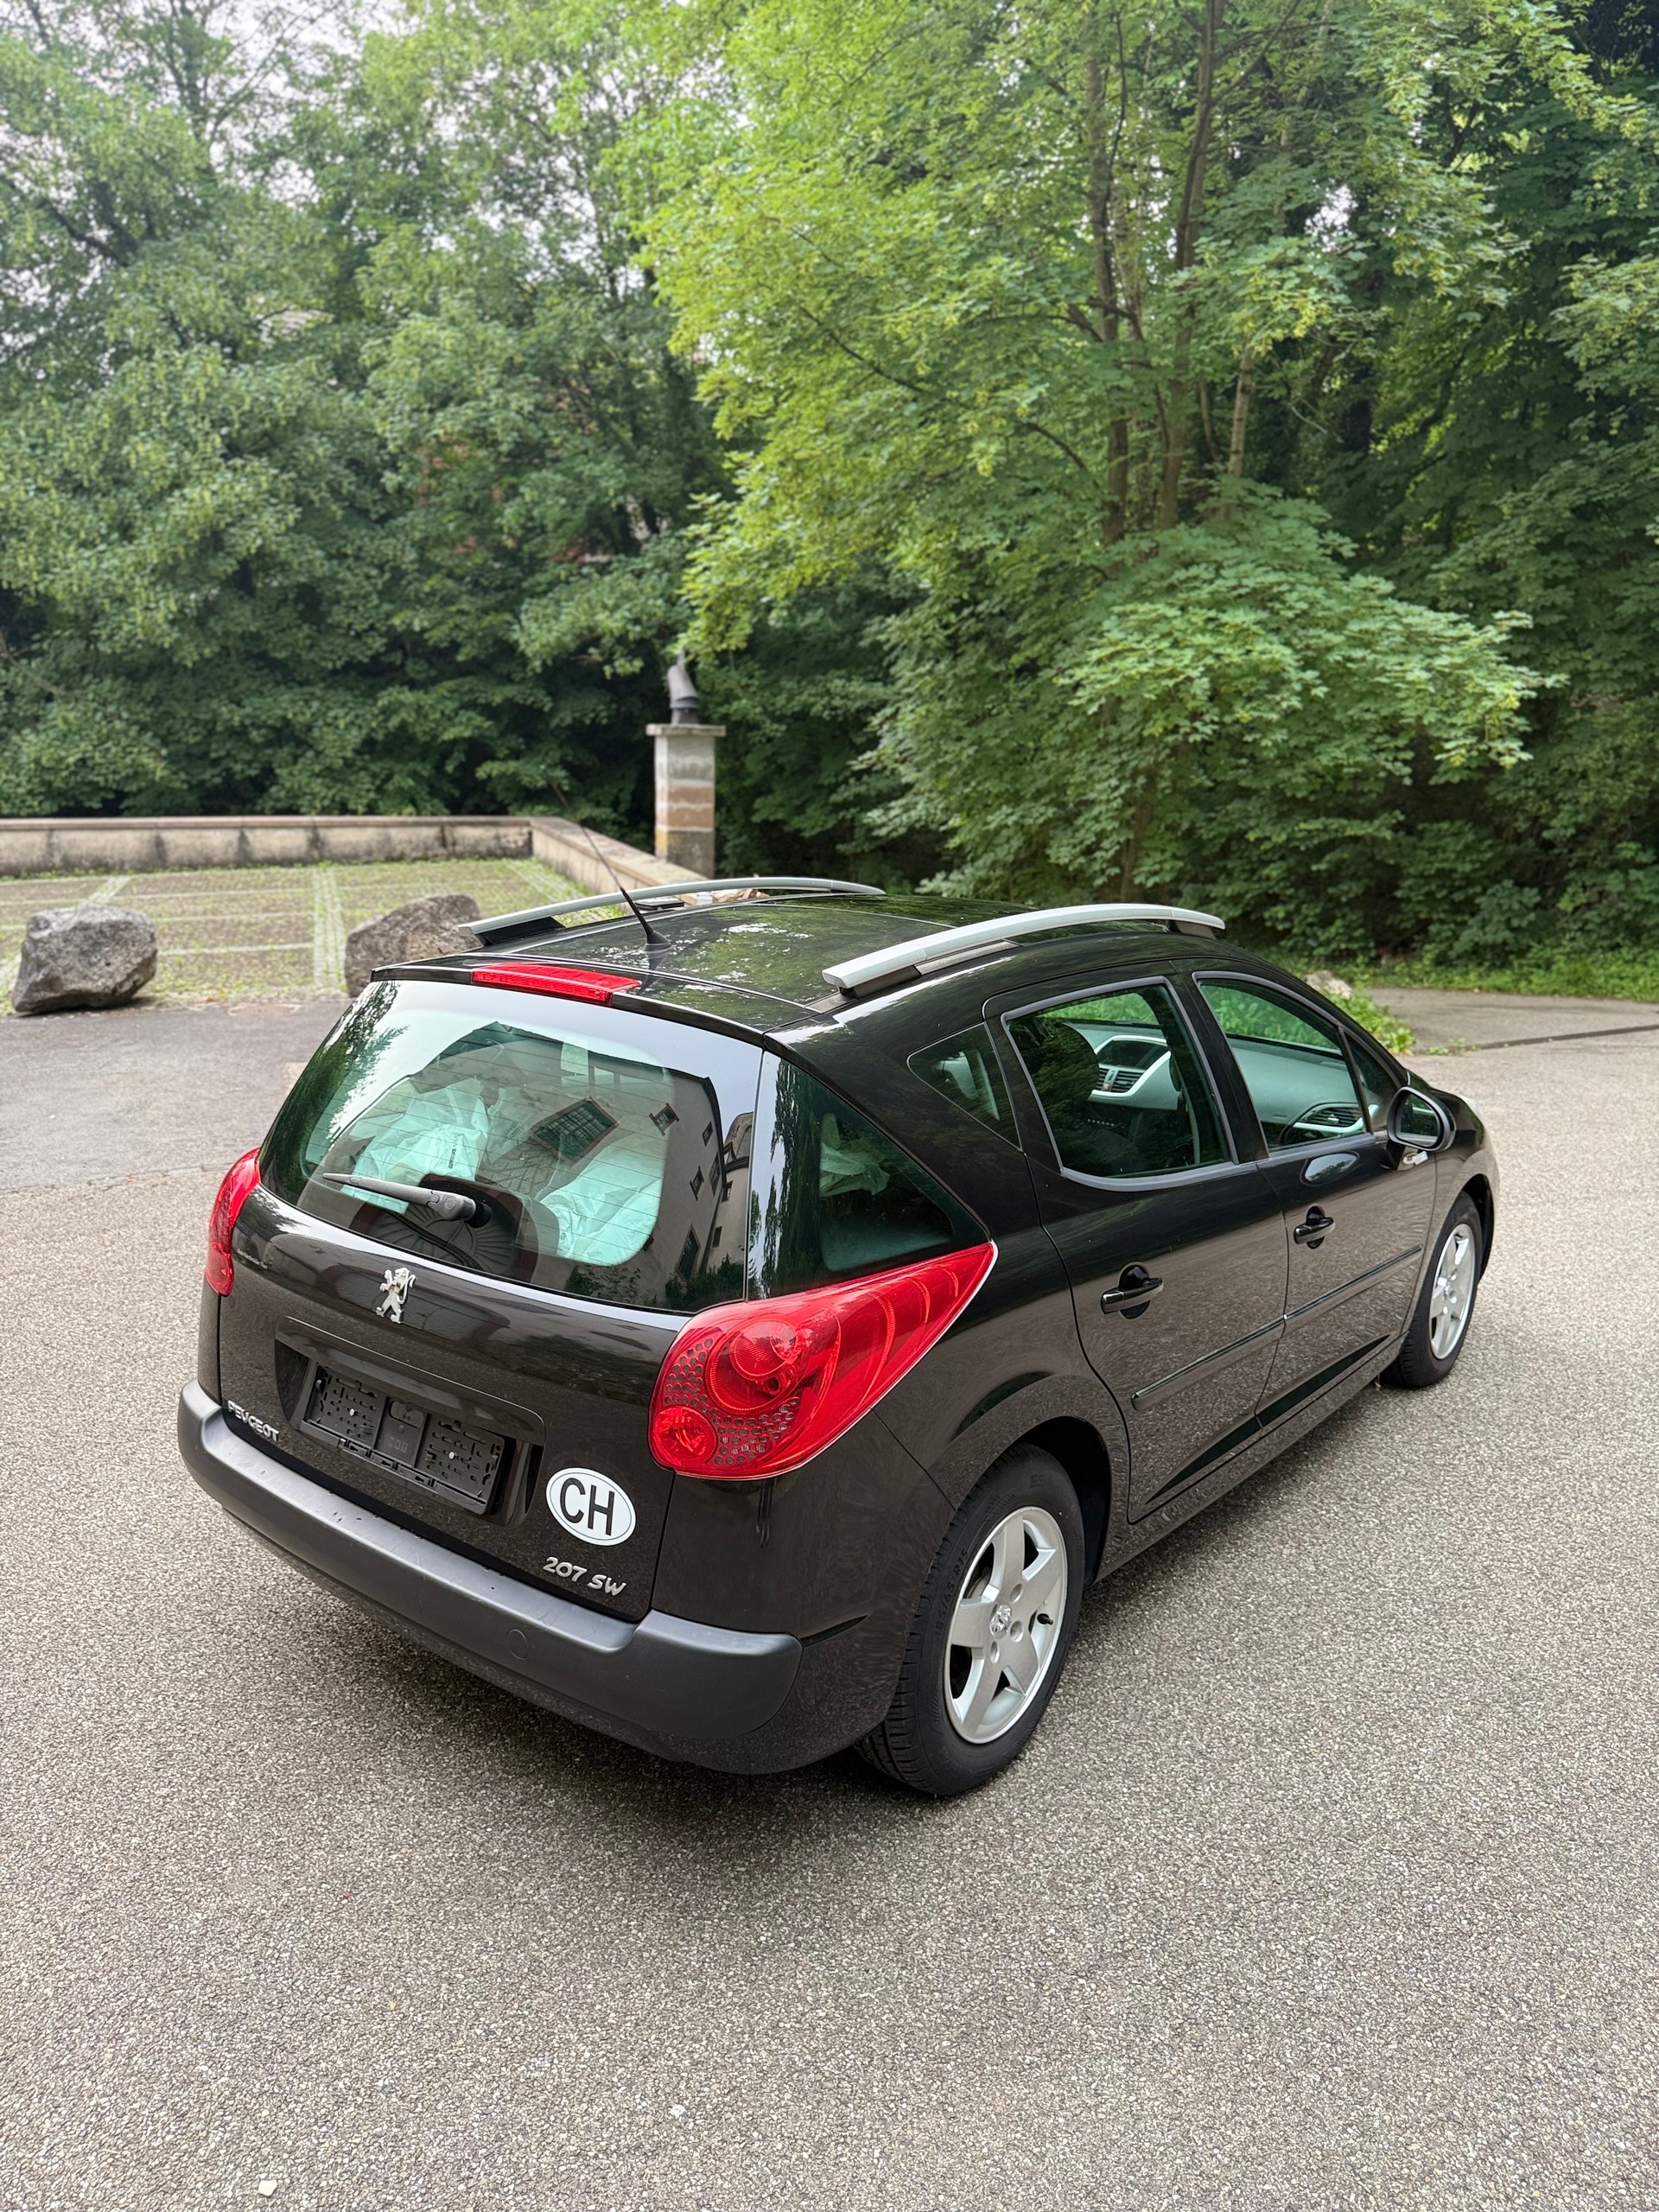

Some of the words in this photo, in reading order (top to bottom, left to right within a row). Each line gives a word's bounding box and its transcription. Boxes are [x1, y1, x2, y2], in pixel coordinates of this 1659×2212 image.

[227, 1400, 279, 1441] PEUGEOT
[560, 1478, 615, 1536] CH
[543, 1556, 588, 1582] 207
[587, 1573, 627, 1596] SW
